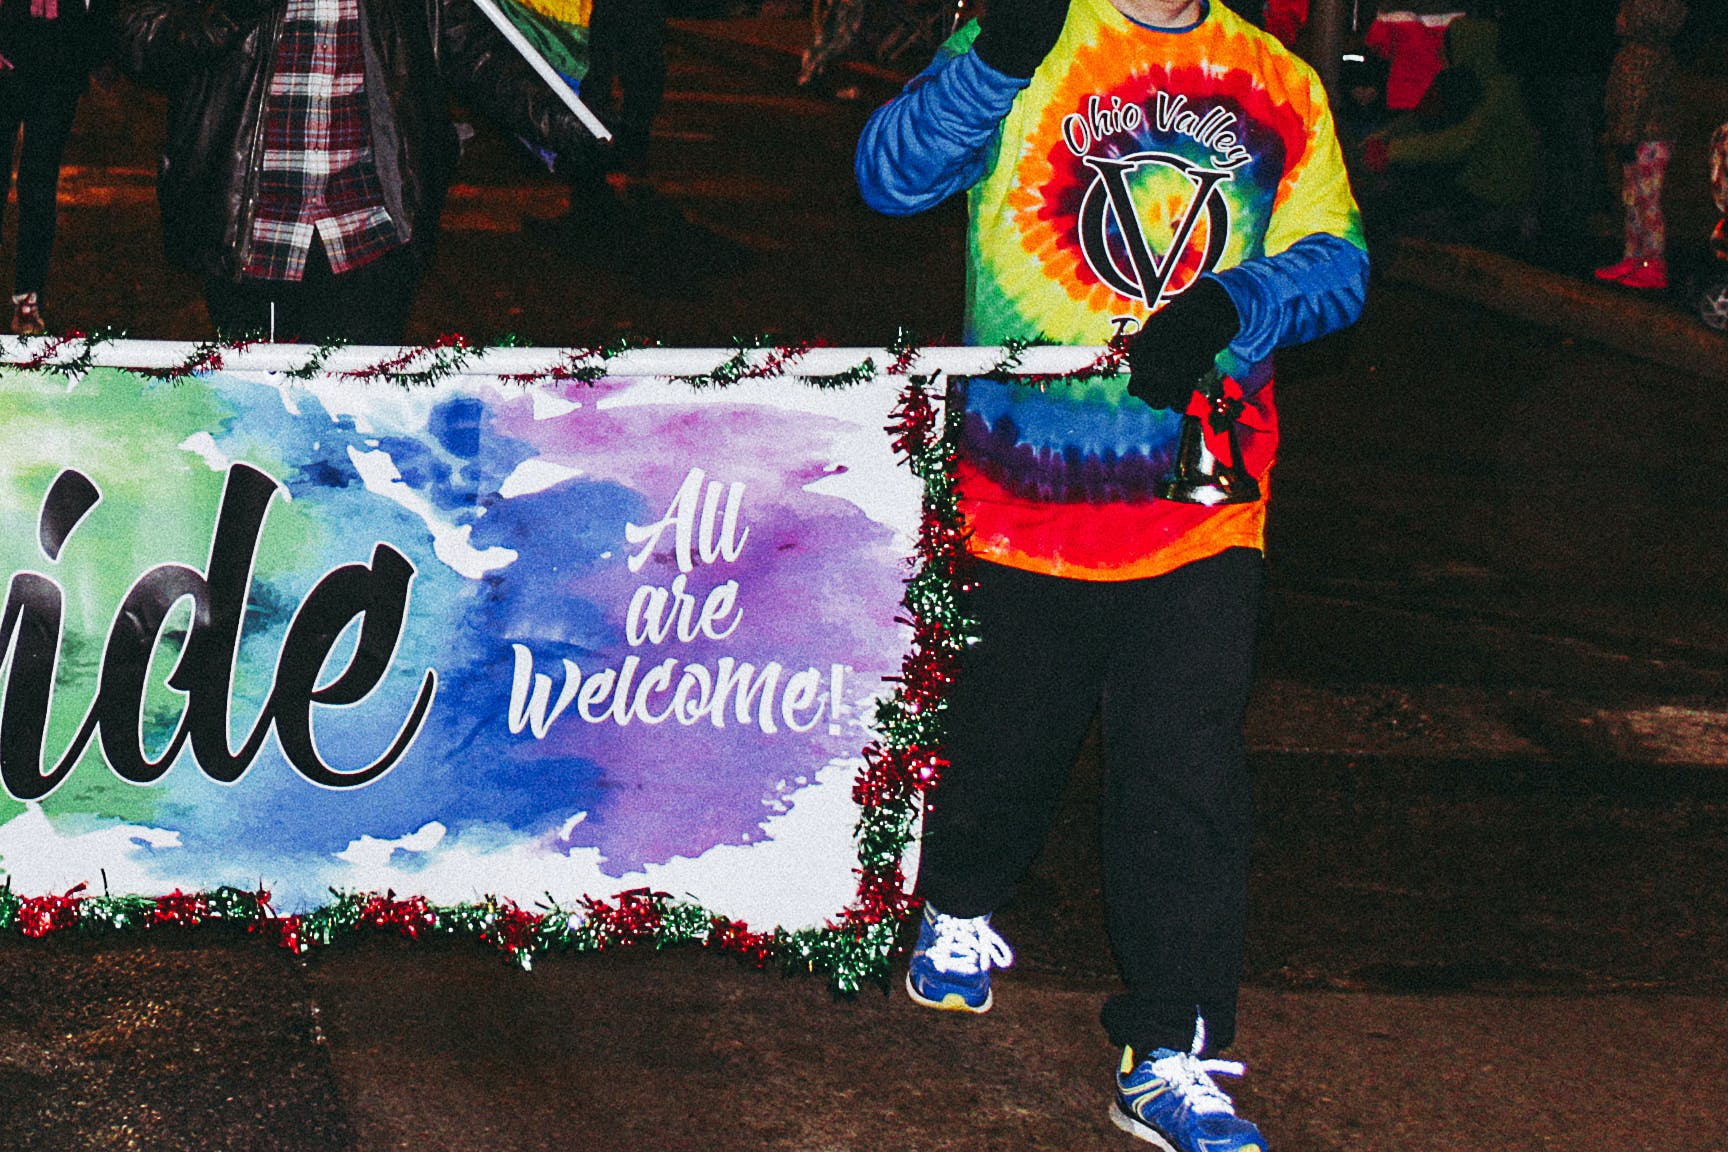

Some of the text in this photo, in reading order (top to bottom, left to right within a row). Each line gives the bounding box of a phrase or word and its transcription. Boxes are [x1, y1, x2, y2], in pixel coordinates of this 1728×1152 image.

[1062, 91, 1254, 170] Ohio Valley
[625, 467, 750, 574] All
[626, 574, 744, 647] are
[508, 644, 845, 739] Welcome!
